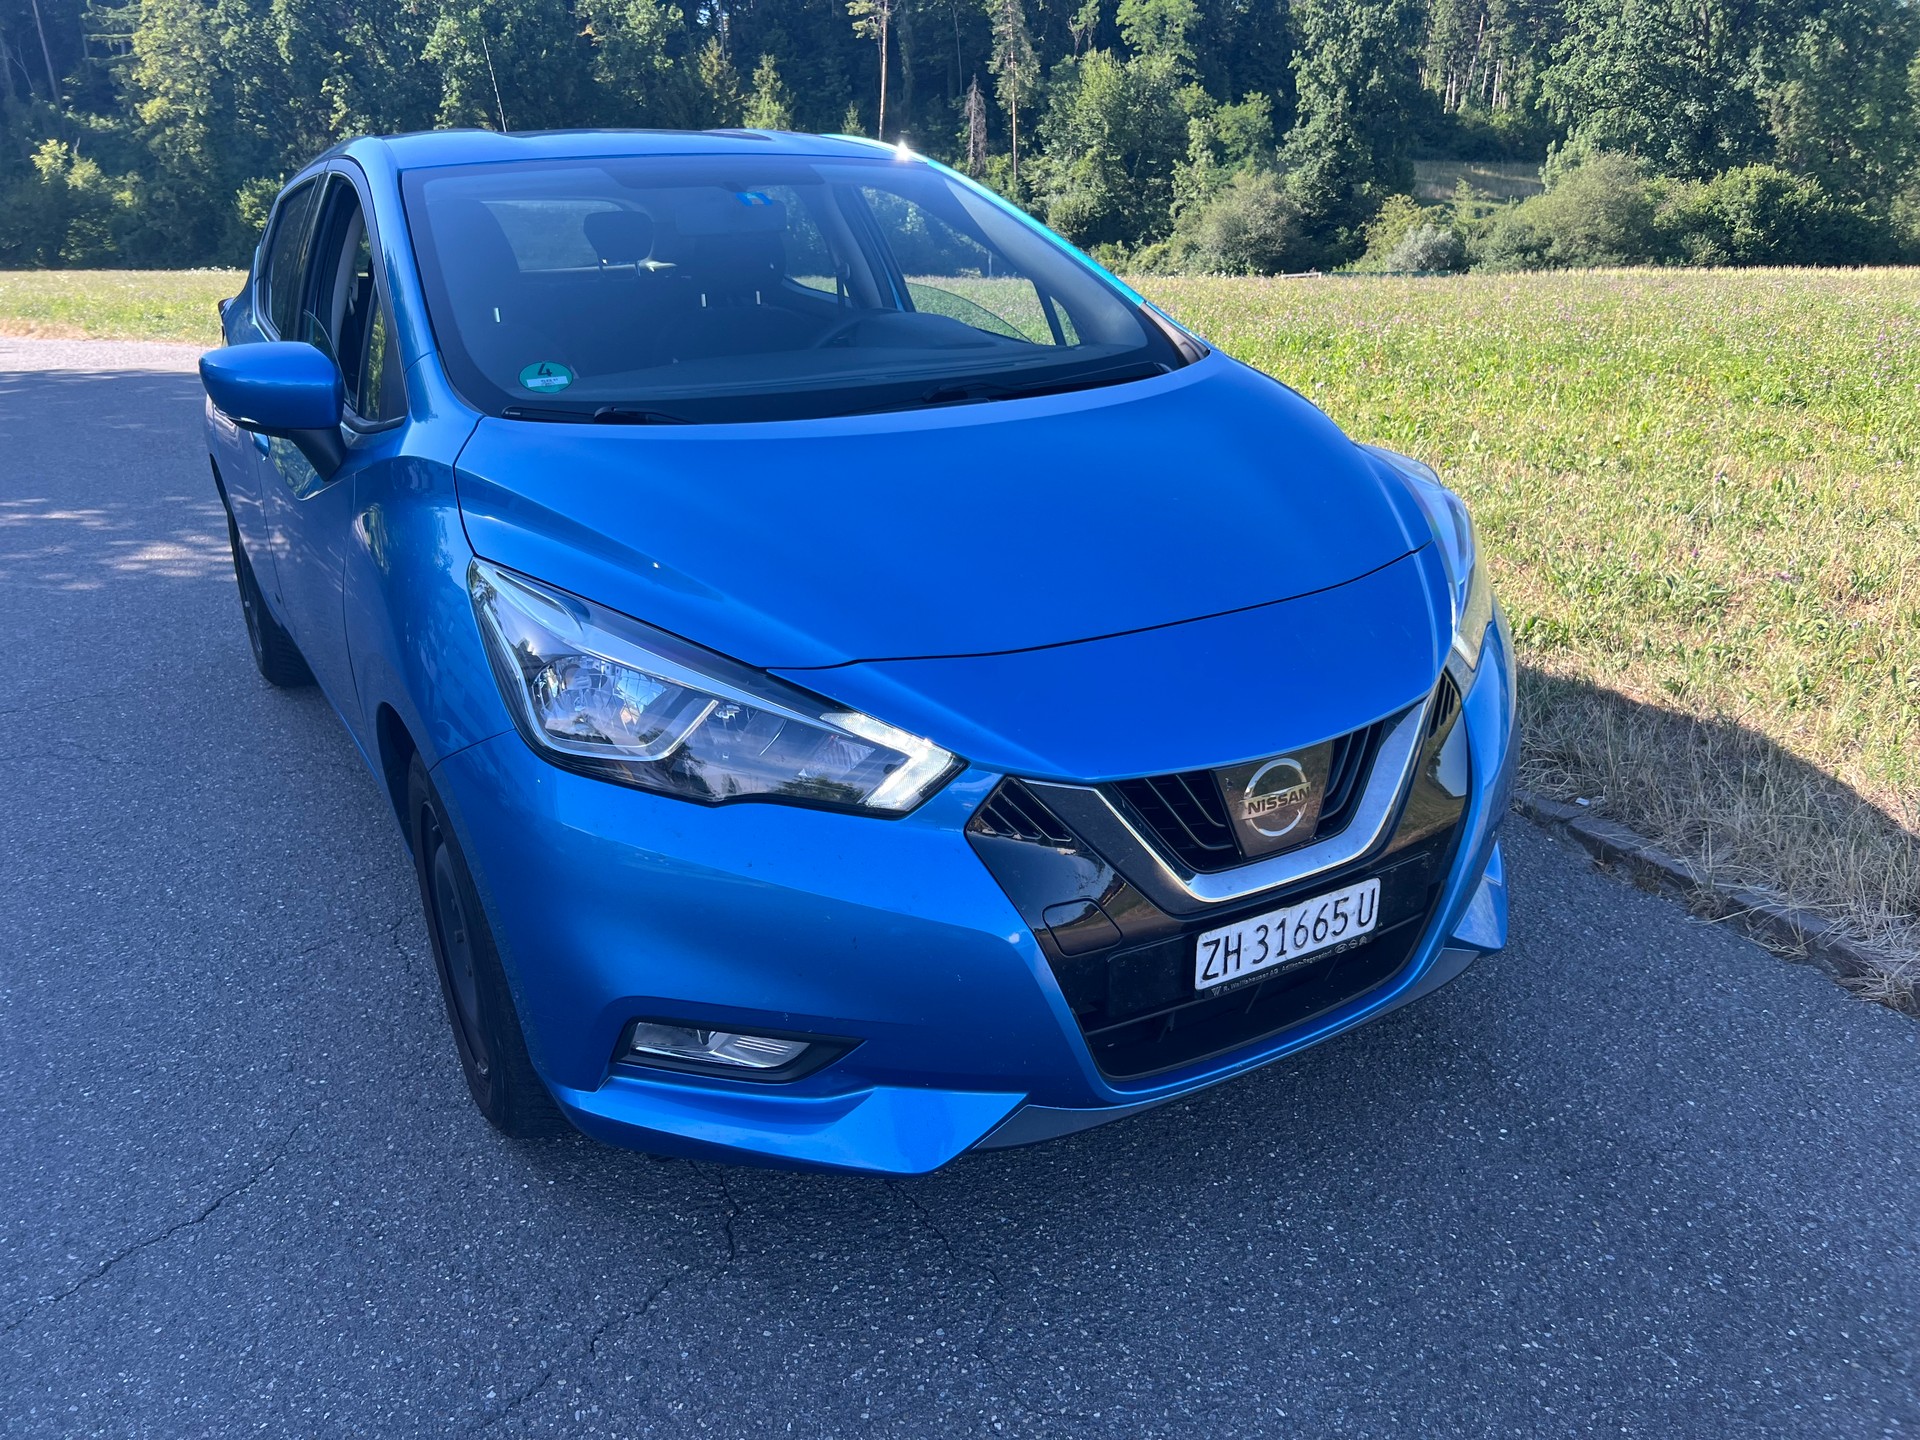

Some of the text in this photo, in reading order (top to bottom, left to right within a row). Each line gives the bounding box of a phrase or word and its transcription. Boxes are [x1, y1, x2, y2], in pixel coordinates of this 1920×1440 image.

[538, 362, 553, 377] 4
[1247, 787, 1310, 815] NISSAN
[1201, 887, 1377, 982] ZH 31665 U
